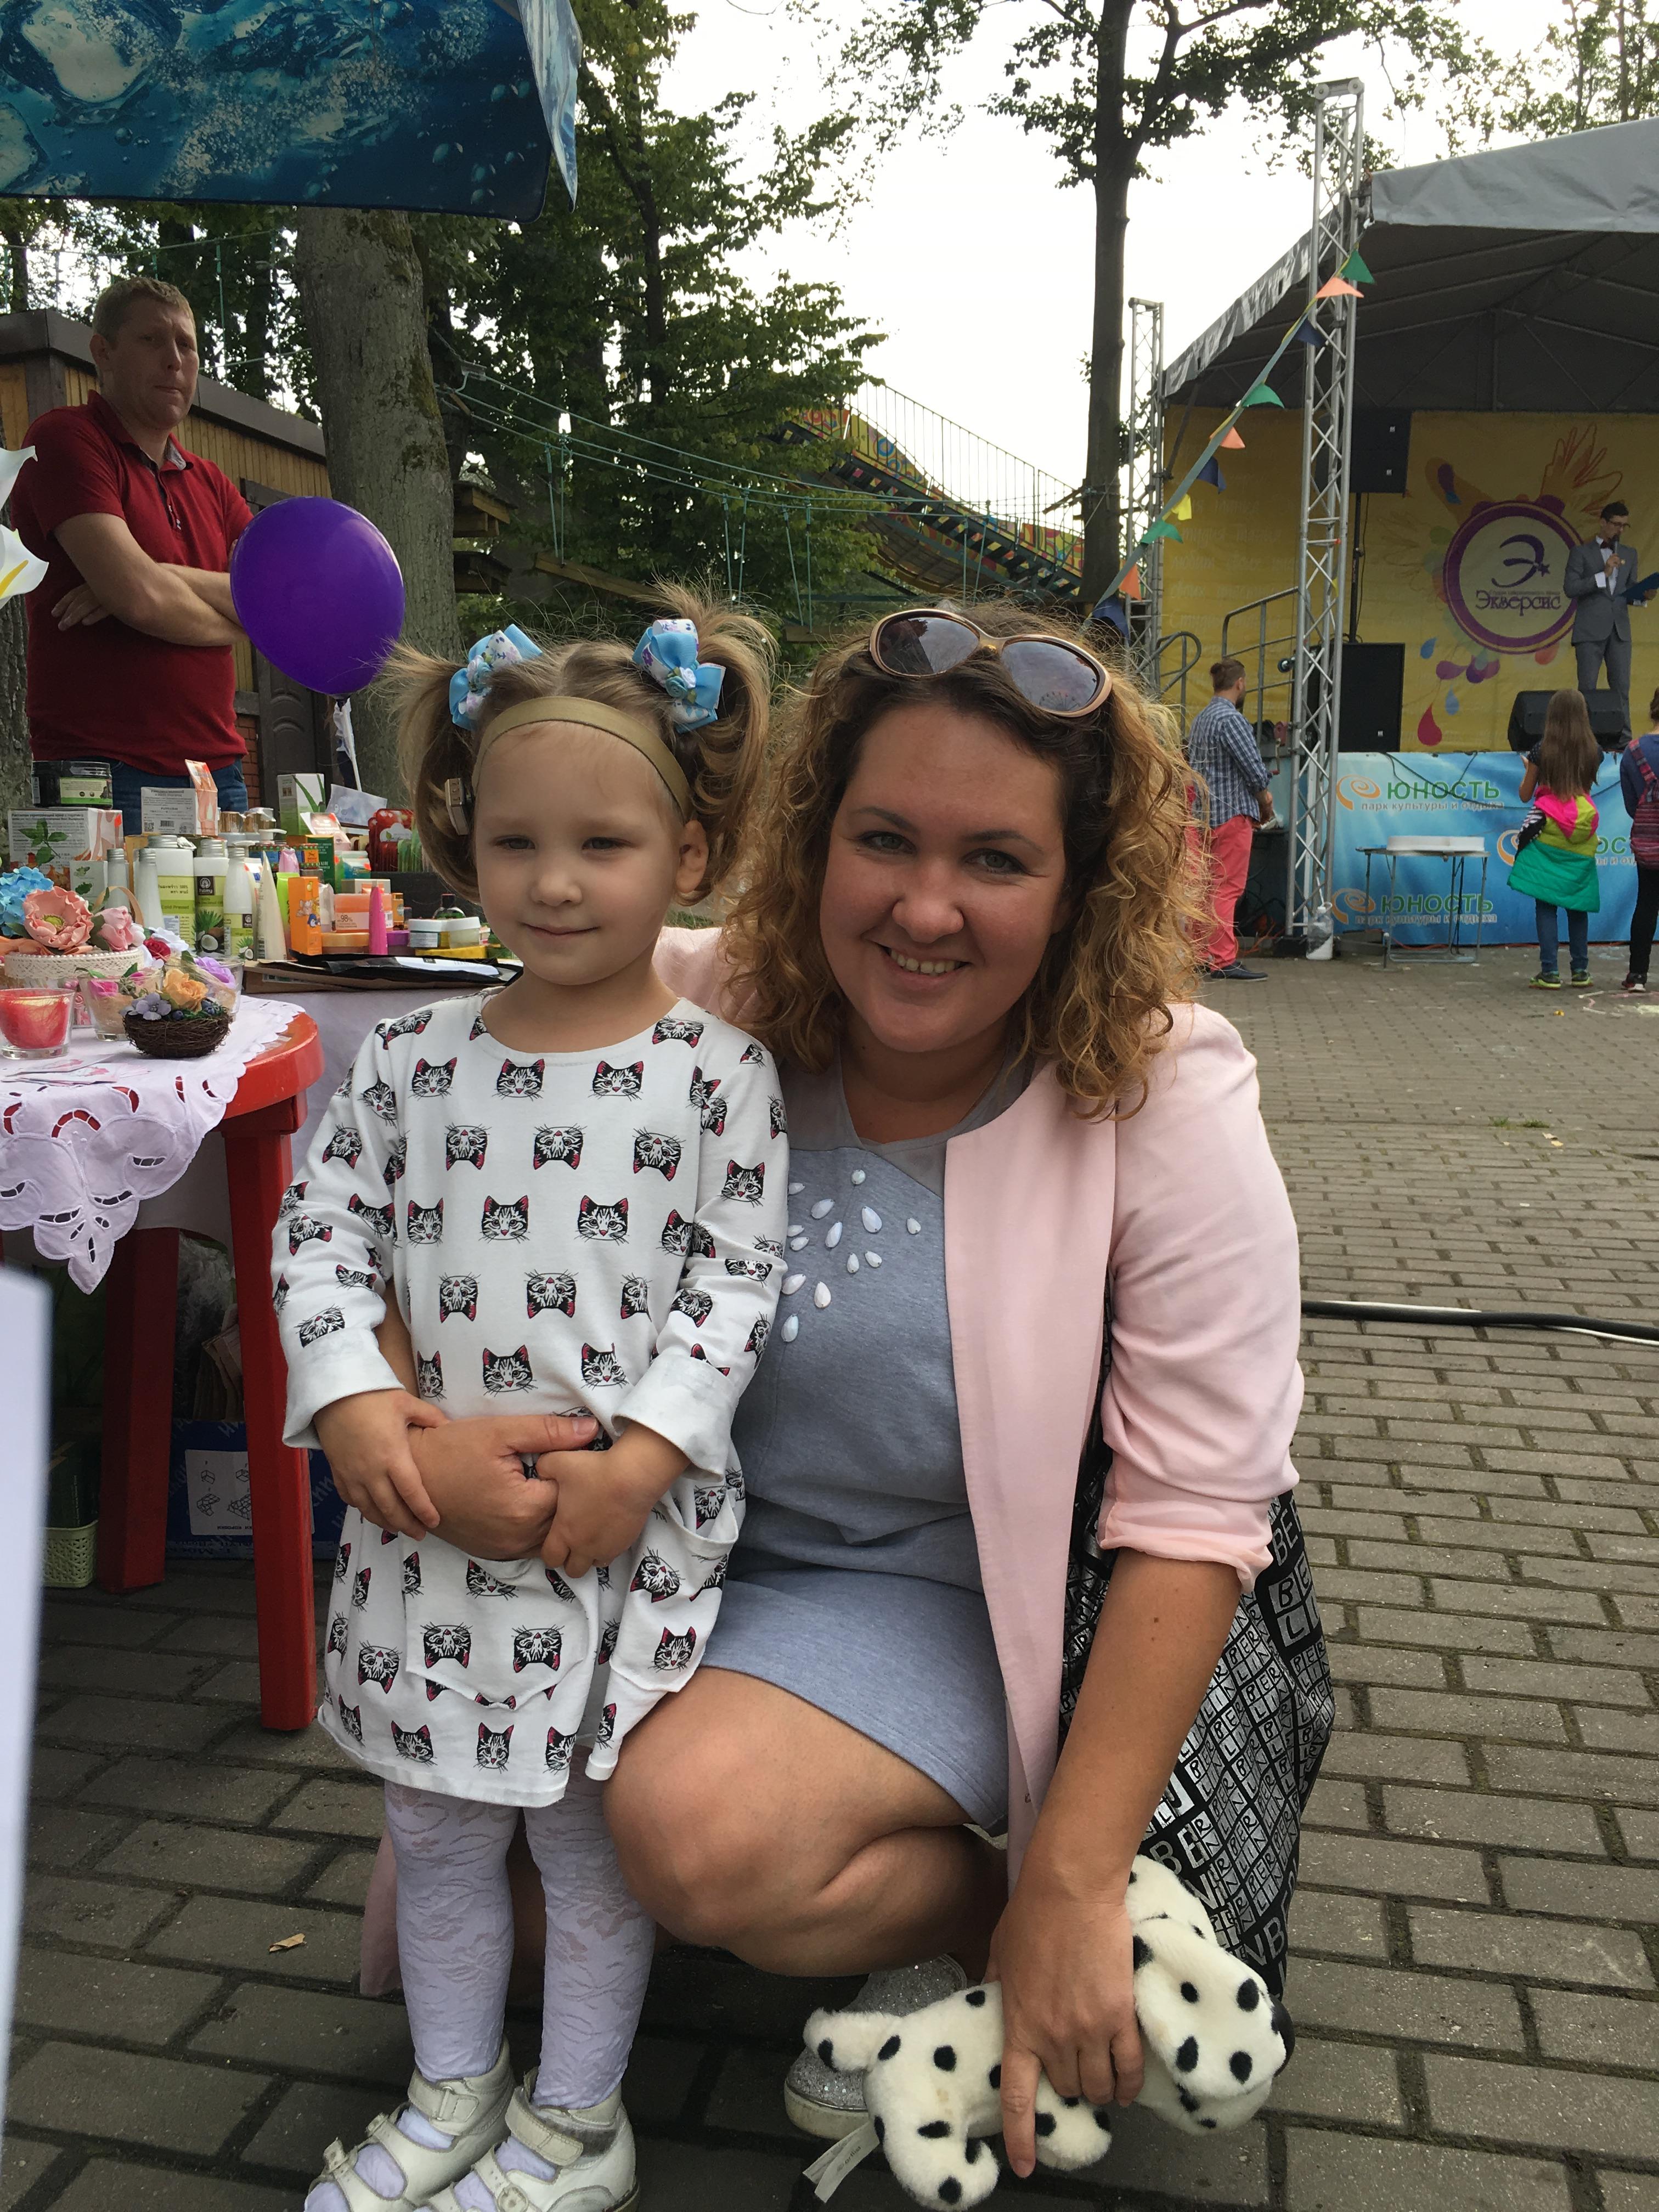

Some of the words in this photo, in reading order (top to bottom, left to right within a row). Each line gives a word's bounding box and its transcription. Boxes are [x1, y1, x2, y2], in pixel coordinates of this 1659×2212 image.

[1362, 802, 1388, 811] парк
[1392, 802, 1447, 811] культуры
[1387, 781, 1499, 799] ЮНОСТЬ
[1381, 894, 1492, 913] ЮНОСТЬ
[1386, 915, 1440, 926] культуры
[1228, 1630, 1259, 1665] BER
[1237, 1642, 1269, 1681] LIN
[1246, 1667, 1280, 1702] BER
[1231, 1815, 1257, 1856] BER
[1239, 1829, 1267, 1873] LIN
